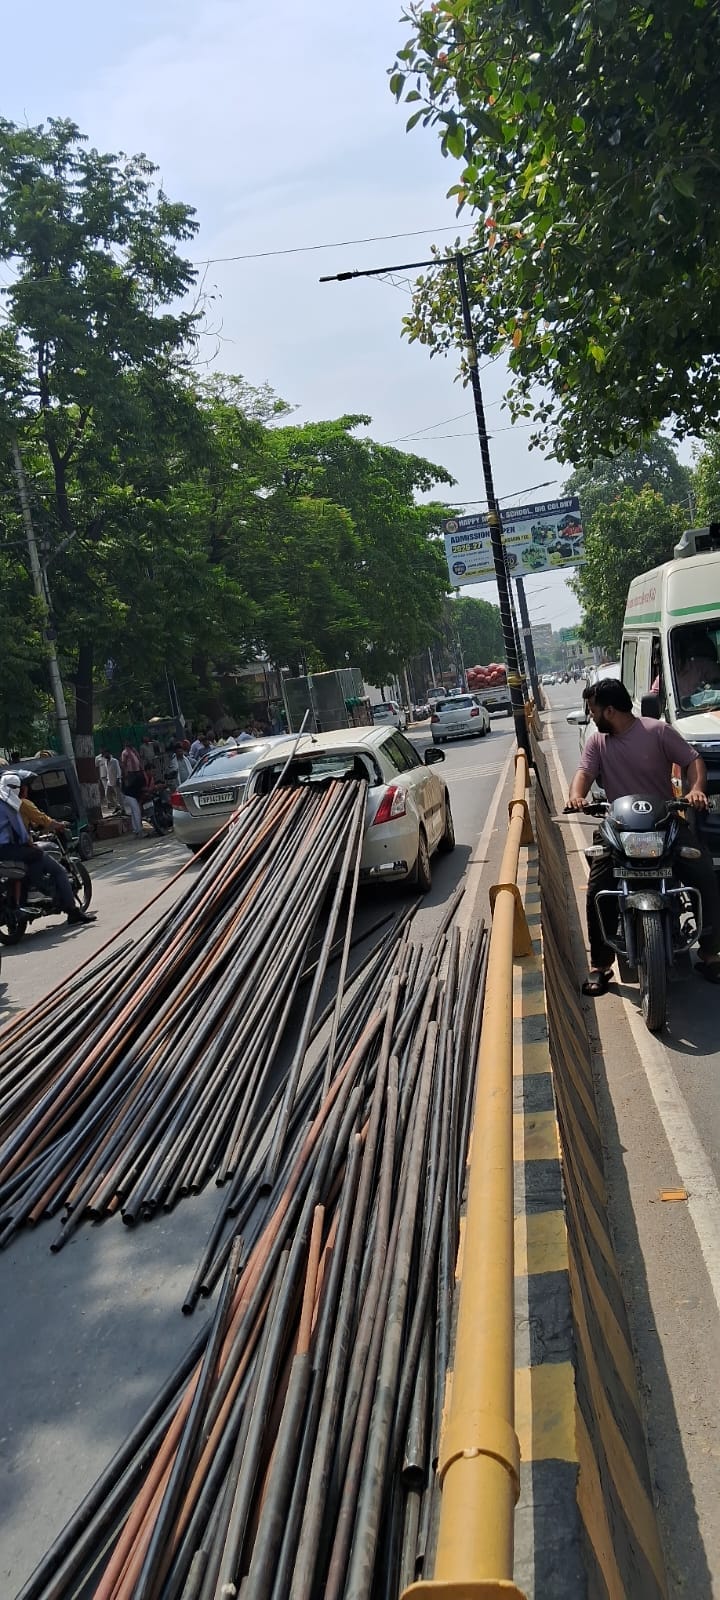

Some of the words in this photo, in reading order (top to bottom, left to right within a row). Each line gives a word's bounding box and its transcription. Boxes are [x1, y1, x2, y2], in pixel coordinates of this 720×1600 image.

[458, 518, 480, 527] HAPPY
[547, 500, 573, 510] COLONY
[450, 531, 490, 544] ADMISSION
[503, 526, 515, 534] PEN
[452, 541, 482, 553] 2026-27
